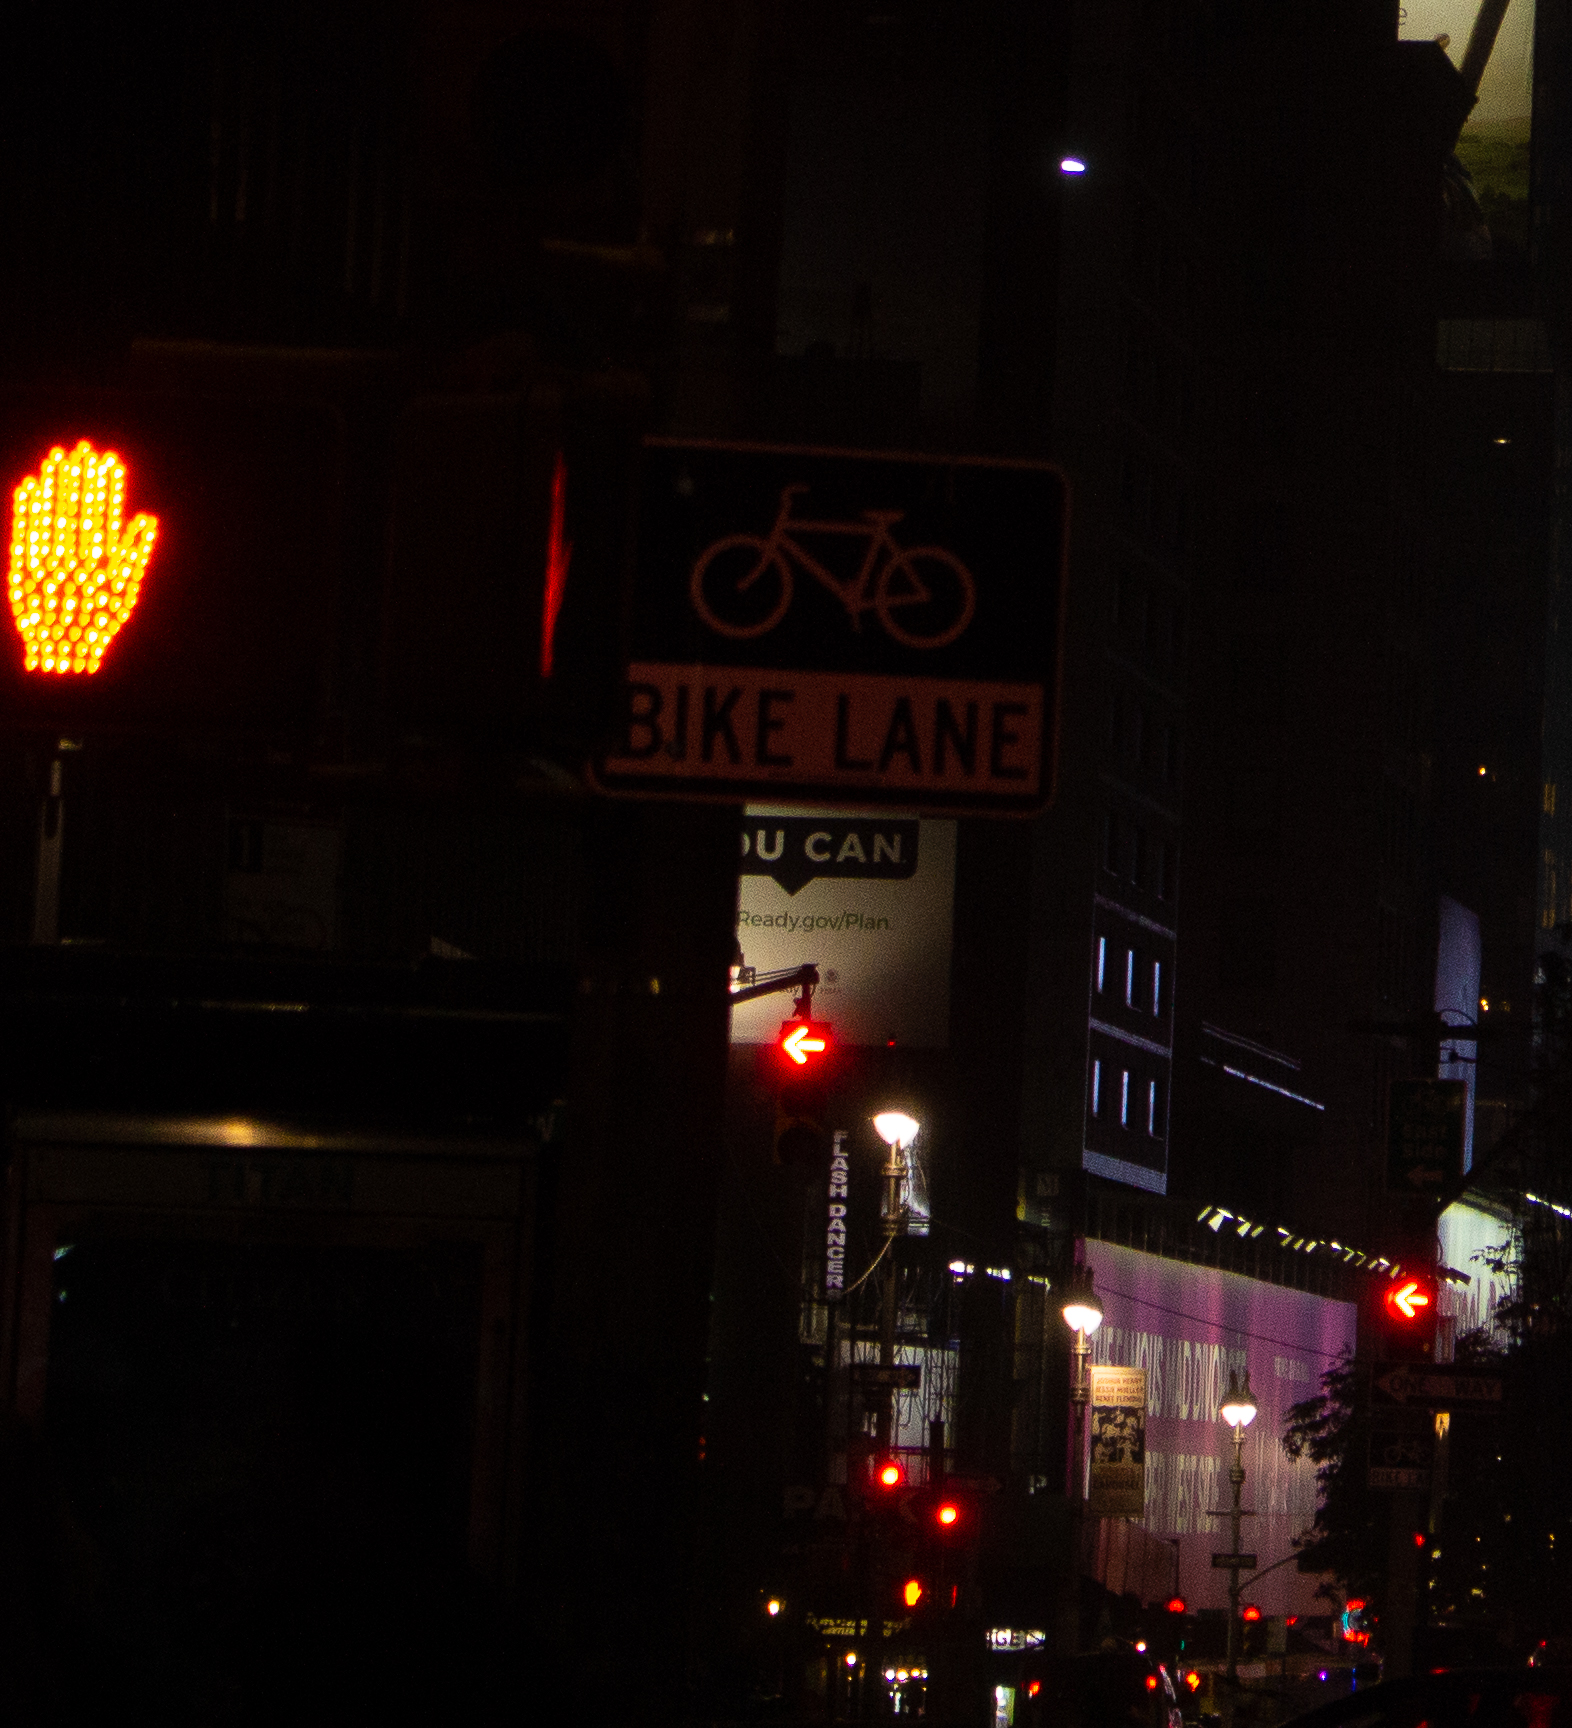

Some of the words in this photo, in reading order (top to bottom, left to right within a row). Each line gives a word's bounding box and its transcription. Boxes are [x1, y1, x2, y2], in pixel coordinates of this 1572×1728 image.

[622, 682, 797, 768] BIKE
[835, 693, 1028, 780] LANE
[804, 832, 902, 864] CAN
[738, 910, 889, 932] Ready.gov/Plan
